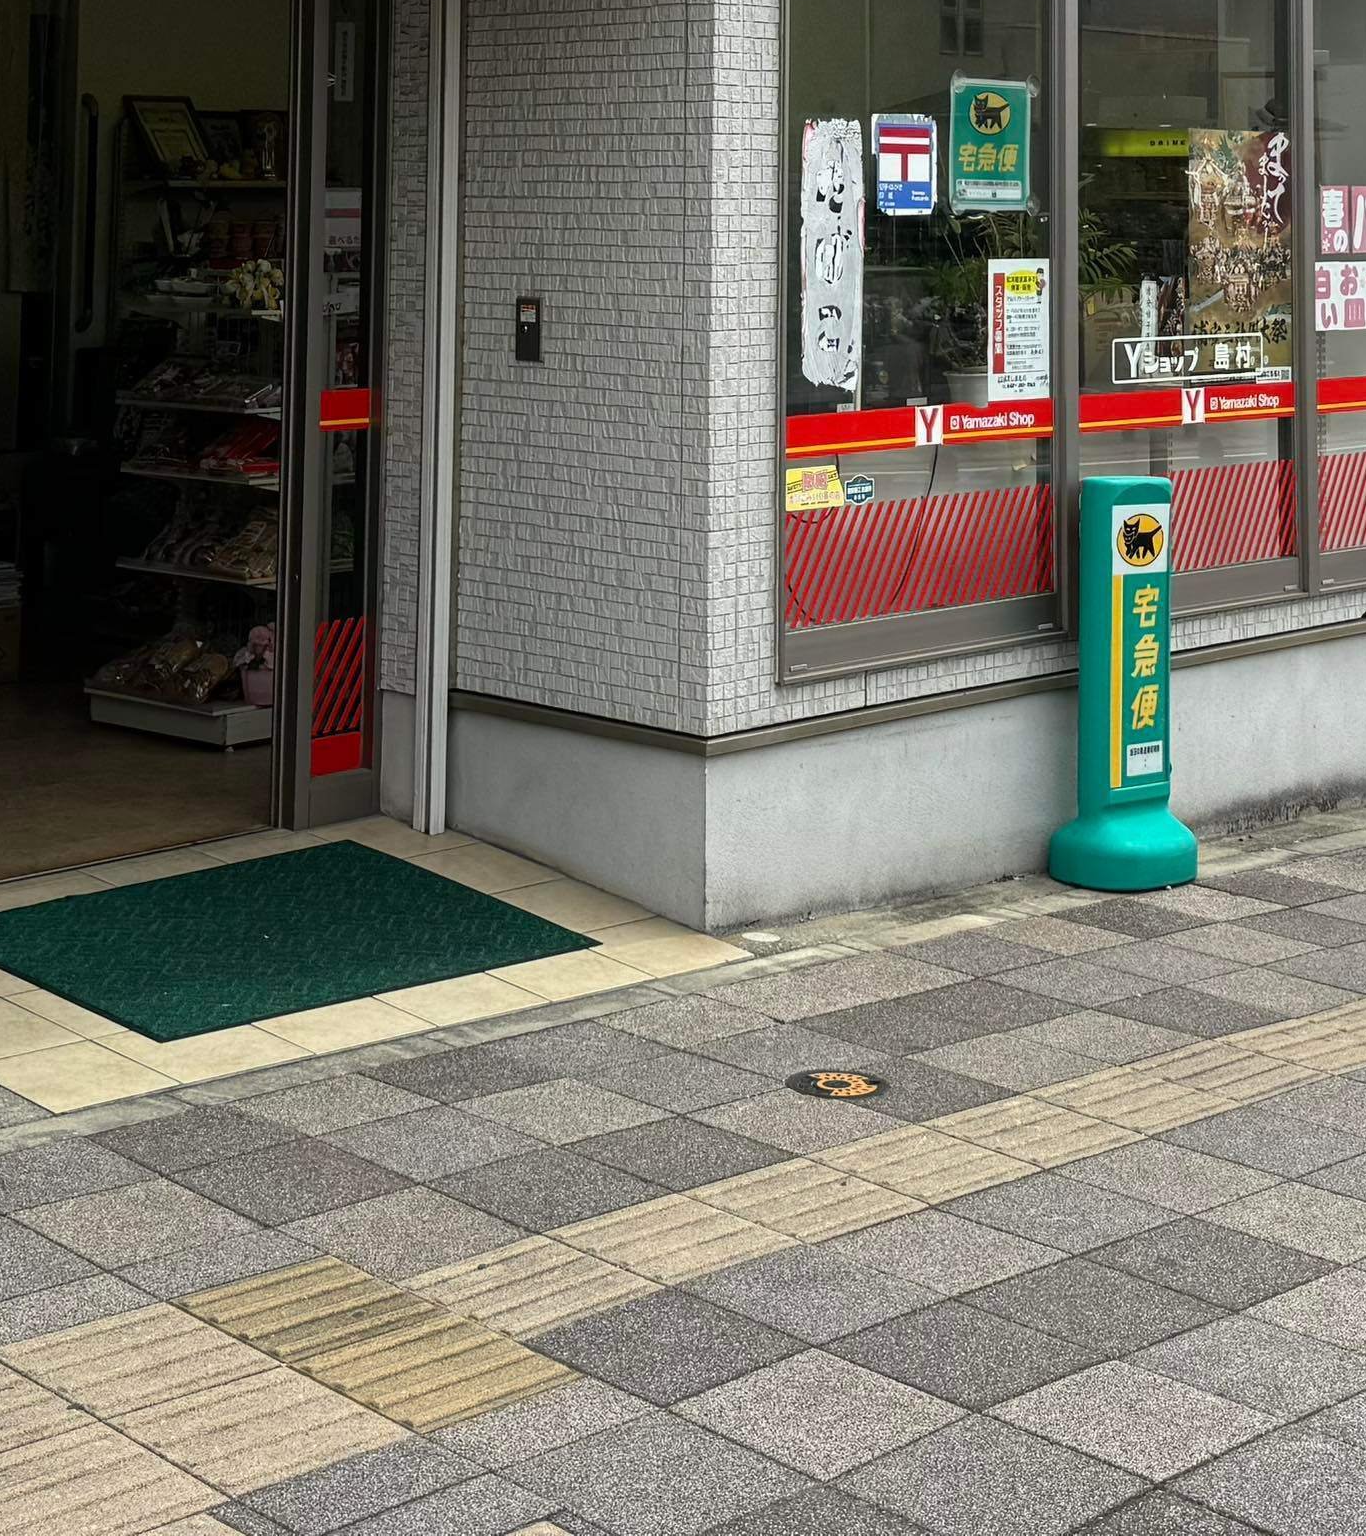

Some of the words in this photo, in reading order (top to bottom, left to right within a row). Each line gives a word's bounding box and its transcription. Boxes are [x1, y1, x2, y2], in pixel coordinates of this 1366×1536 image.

[958, 142, 1020, 173] 宅急便
[1214, 342, 1252, 370] 島村
[1185, 390, 1202, 421] Y
[1219, 396, 1257, 410] Yamazaki
[1259, 394, 1280, 409] Shop
[919, 407, 939, 444] Y
[961, 413, 1008, 429] Yamazaki
[1009, 411, 1035, 428] Shop
[1130, 584, 1159, 731] 宅急便
